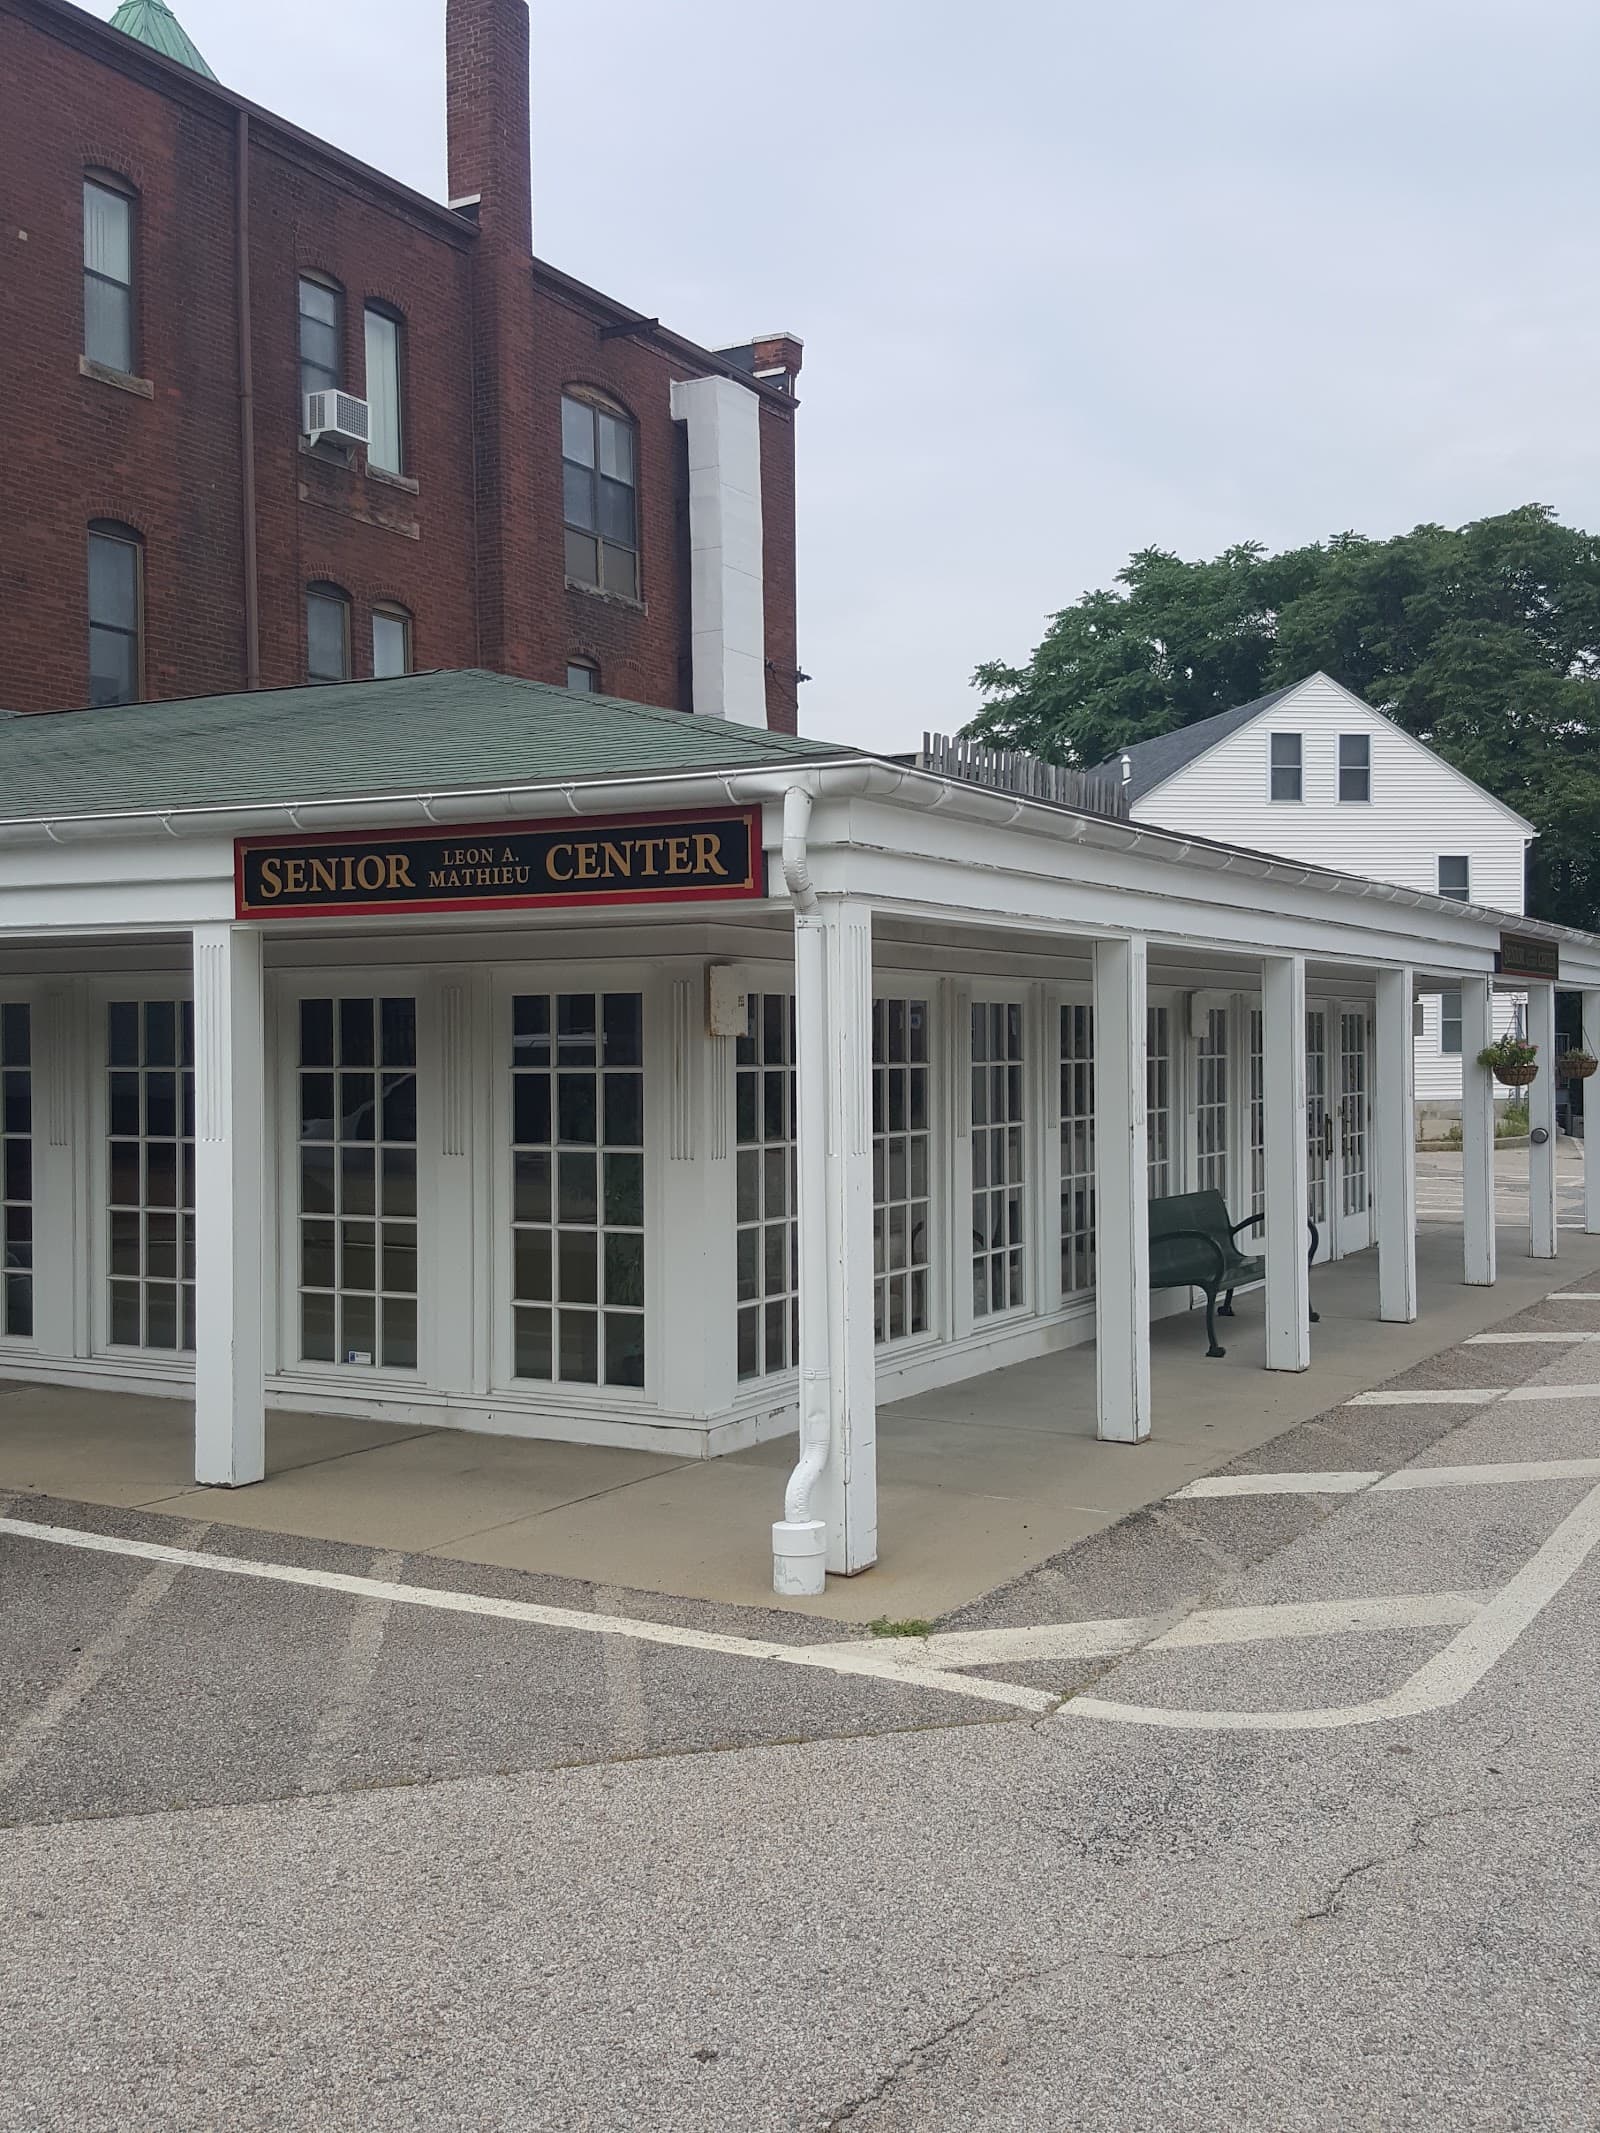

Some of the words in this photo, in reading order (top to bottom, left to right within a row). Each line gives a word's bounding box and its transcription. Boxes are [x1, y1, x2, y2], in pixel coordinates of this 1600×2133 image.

[443, 847, 494, 866] LEON
[501, 847, 519, 862] A.
[545, 833, 729, 881] CENTER
[260, 854, 416, 898] SENIOR
[428, 866, 531, 888] MATHIEU
